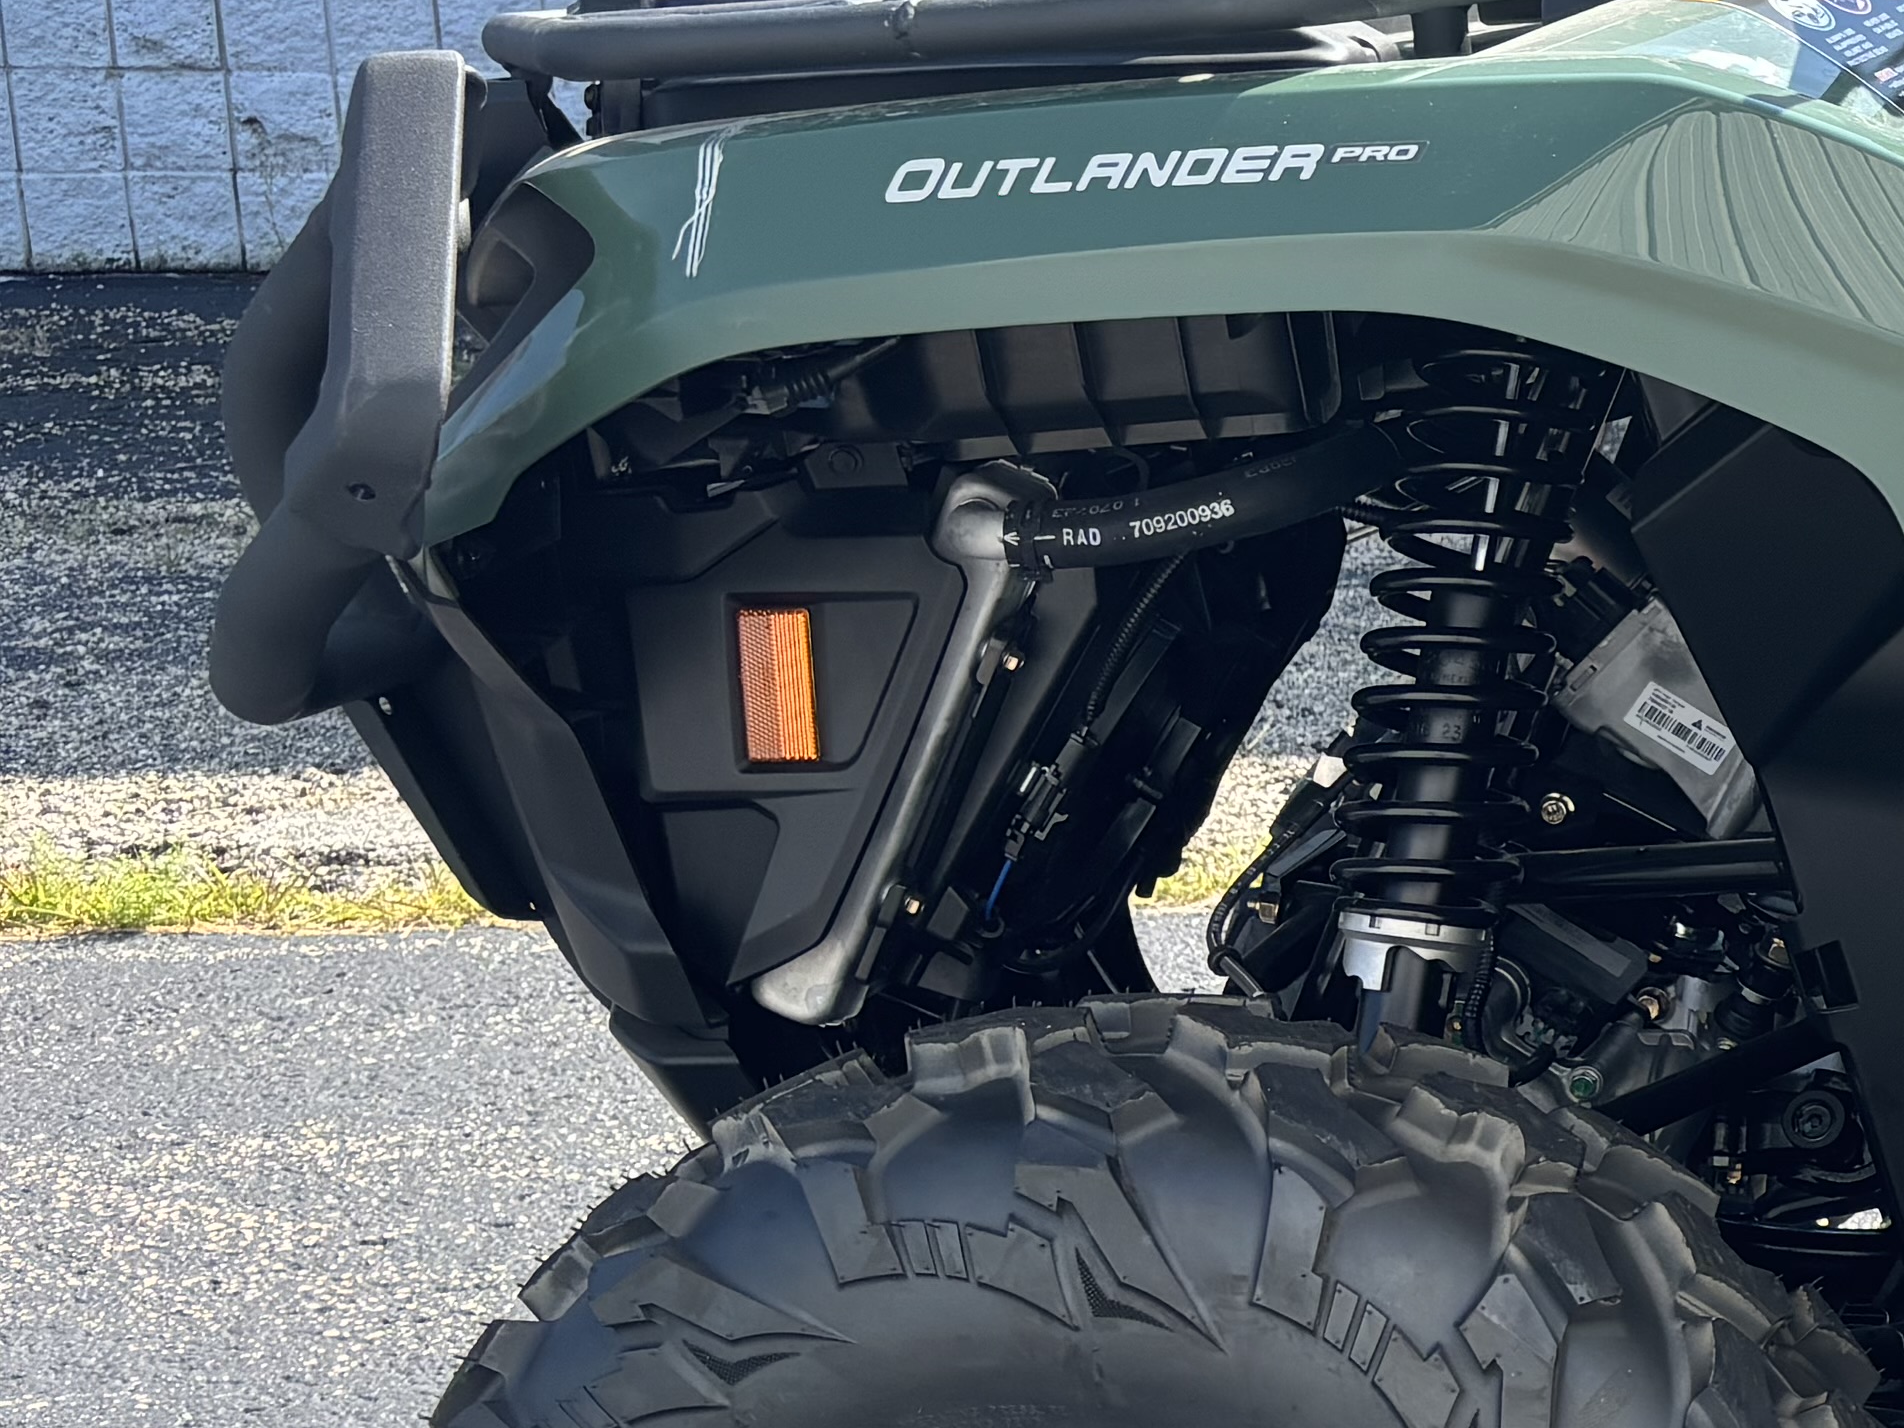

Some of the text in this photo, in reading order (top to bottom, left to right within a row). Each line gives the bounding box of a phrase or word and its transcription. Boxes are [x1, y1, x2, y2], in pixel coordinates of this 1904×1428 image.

[886, 144, 1419, 202] OUTLANDER PRO
[1062, 527, 1101, 546] RAD
[1130, 497, 1235, 538] 709200936
